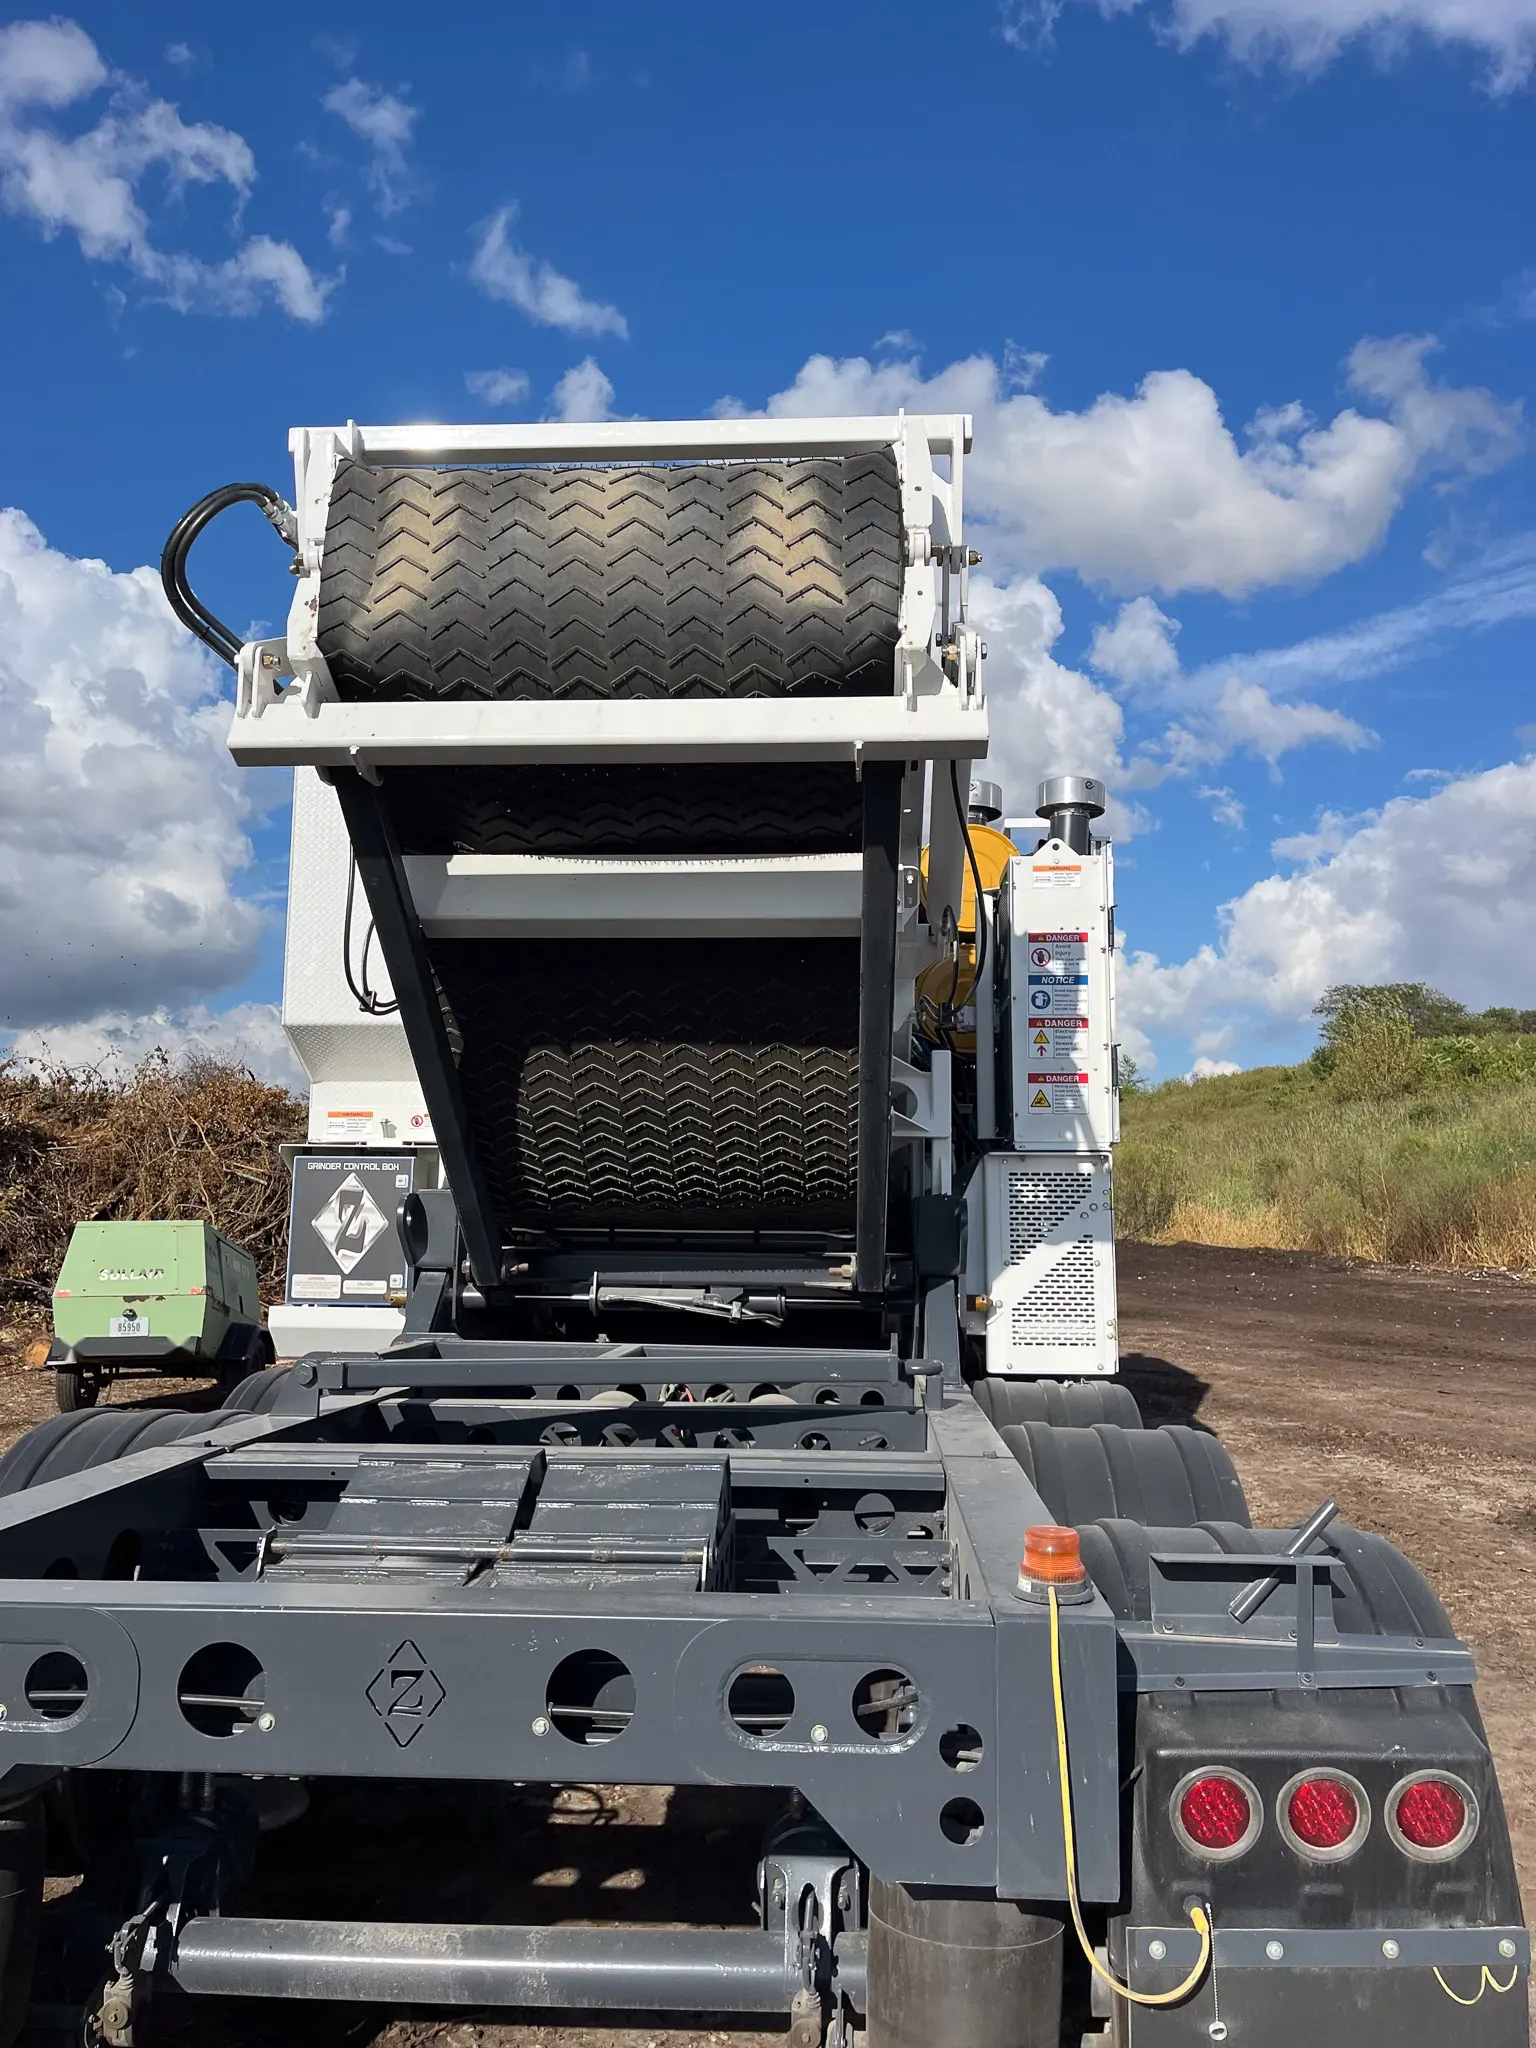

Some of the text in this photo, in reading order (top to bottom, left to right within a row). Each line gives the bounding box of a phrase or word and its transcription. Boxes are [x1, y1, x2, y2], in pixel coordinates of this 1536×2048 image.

[1041, 976, 1076, 984] NOTICE
[1044, 1019, 1083, 1027] DANGER
[307, 1162, 400, 1171] GRINDER CONTROL BOX
[99, 1268, 165, 1281] SULLAIR
[117, 1322, 141, 1333] 85950
[387, 1669, 425, 1718] Z
